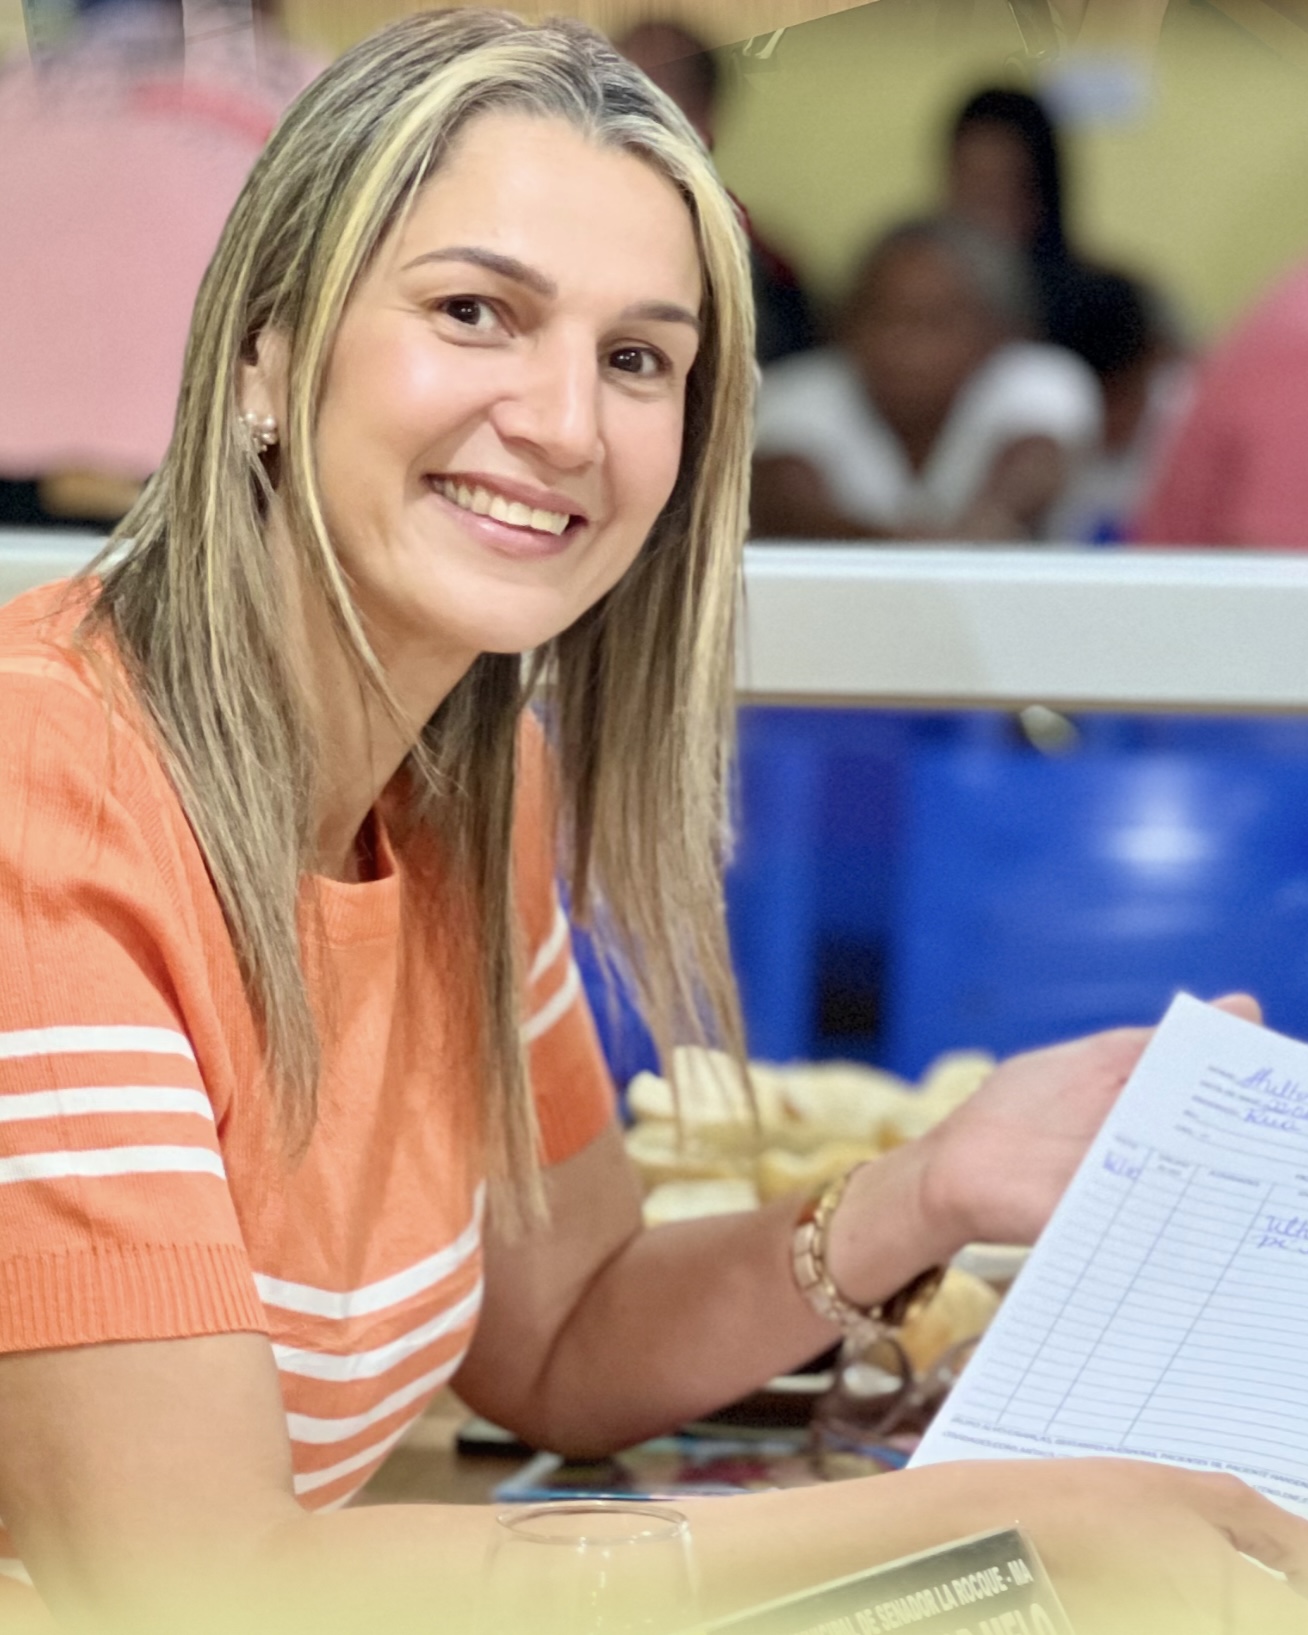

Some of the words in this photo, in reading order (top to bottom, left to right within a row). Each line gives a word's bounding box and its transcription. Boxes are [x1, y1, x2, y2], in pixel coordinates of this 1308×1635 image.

[1244, 1108, 1300, 1133] Rua
[854, 1608, 882, 1635] DE
[875, 1590, 942, 1631] SENADOR
[933, 1584, 960, 1612] LA
[952, 1566, 1009, 1606] ROCQUE
